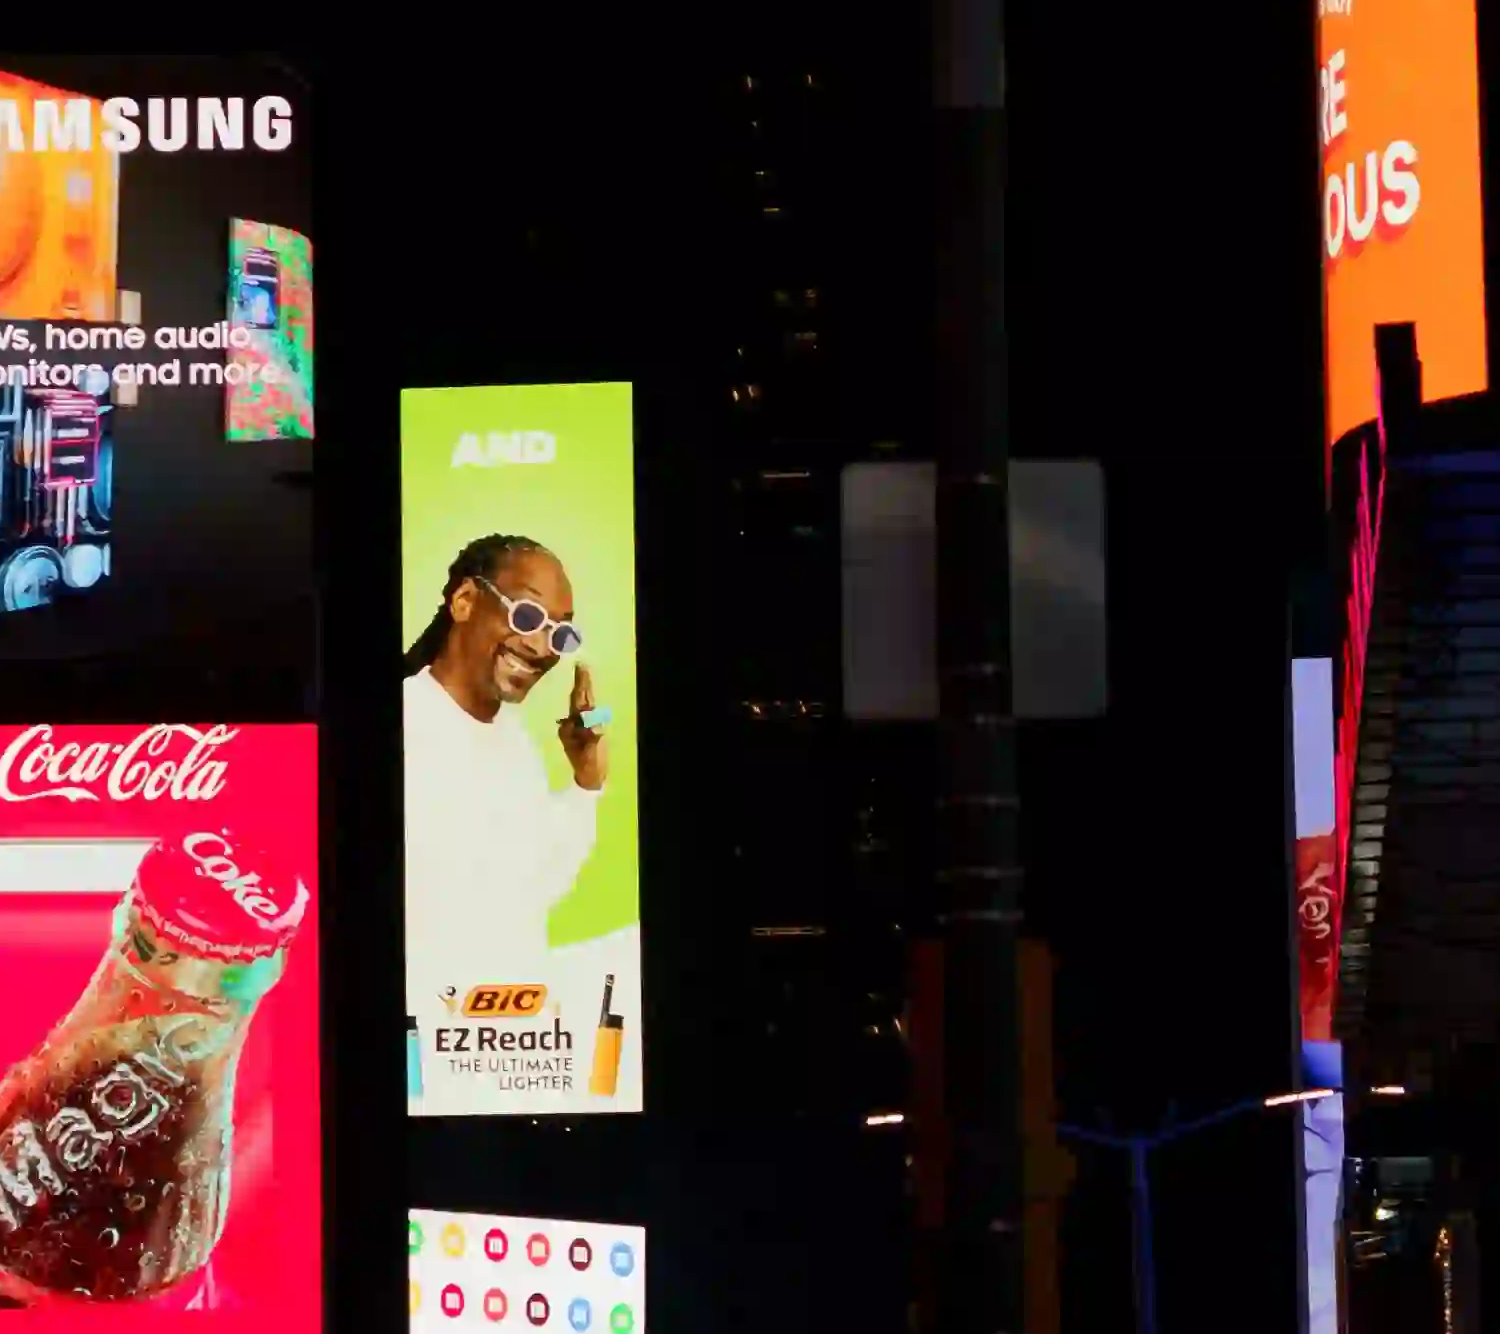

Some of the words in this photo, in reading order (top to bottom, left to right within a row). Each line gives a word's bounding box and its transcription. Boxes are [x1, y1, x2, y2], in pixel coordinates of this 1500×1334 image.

[44, 322, 147, 351] home
[112, 358, 181, 387] and
[434, 1026, 469, 1052] EZ
[476, 1017, 574, 1052] Reach
[448, 1056, 484, 1075] THE
[488, 1055, 573, 1075] ULTIMATE
[498, 1073, 574, 1093] LIGHTER
